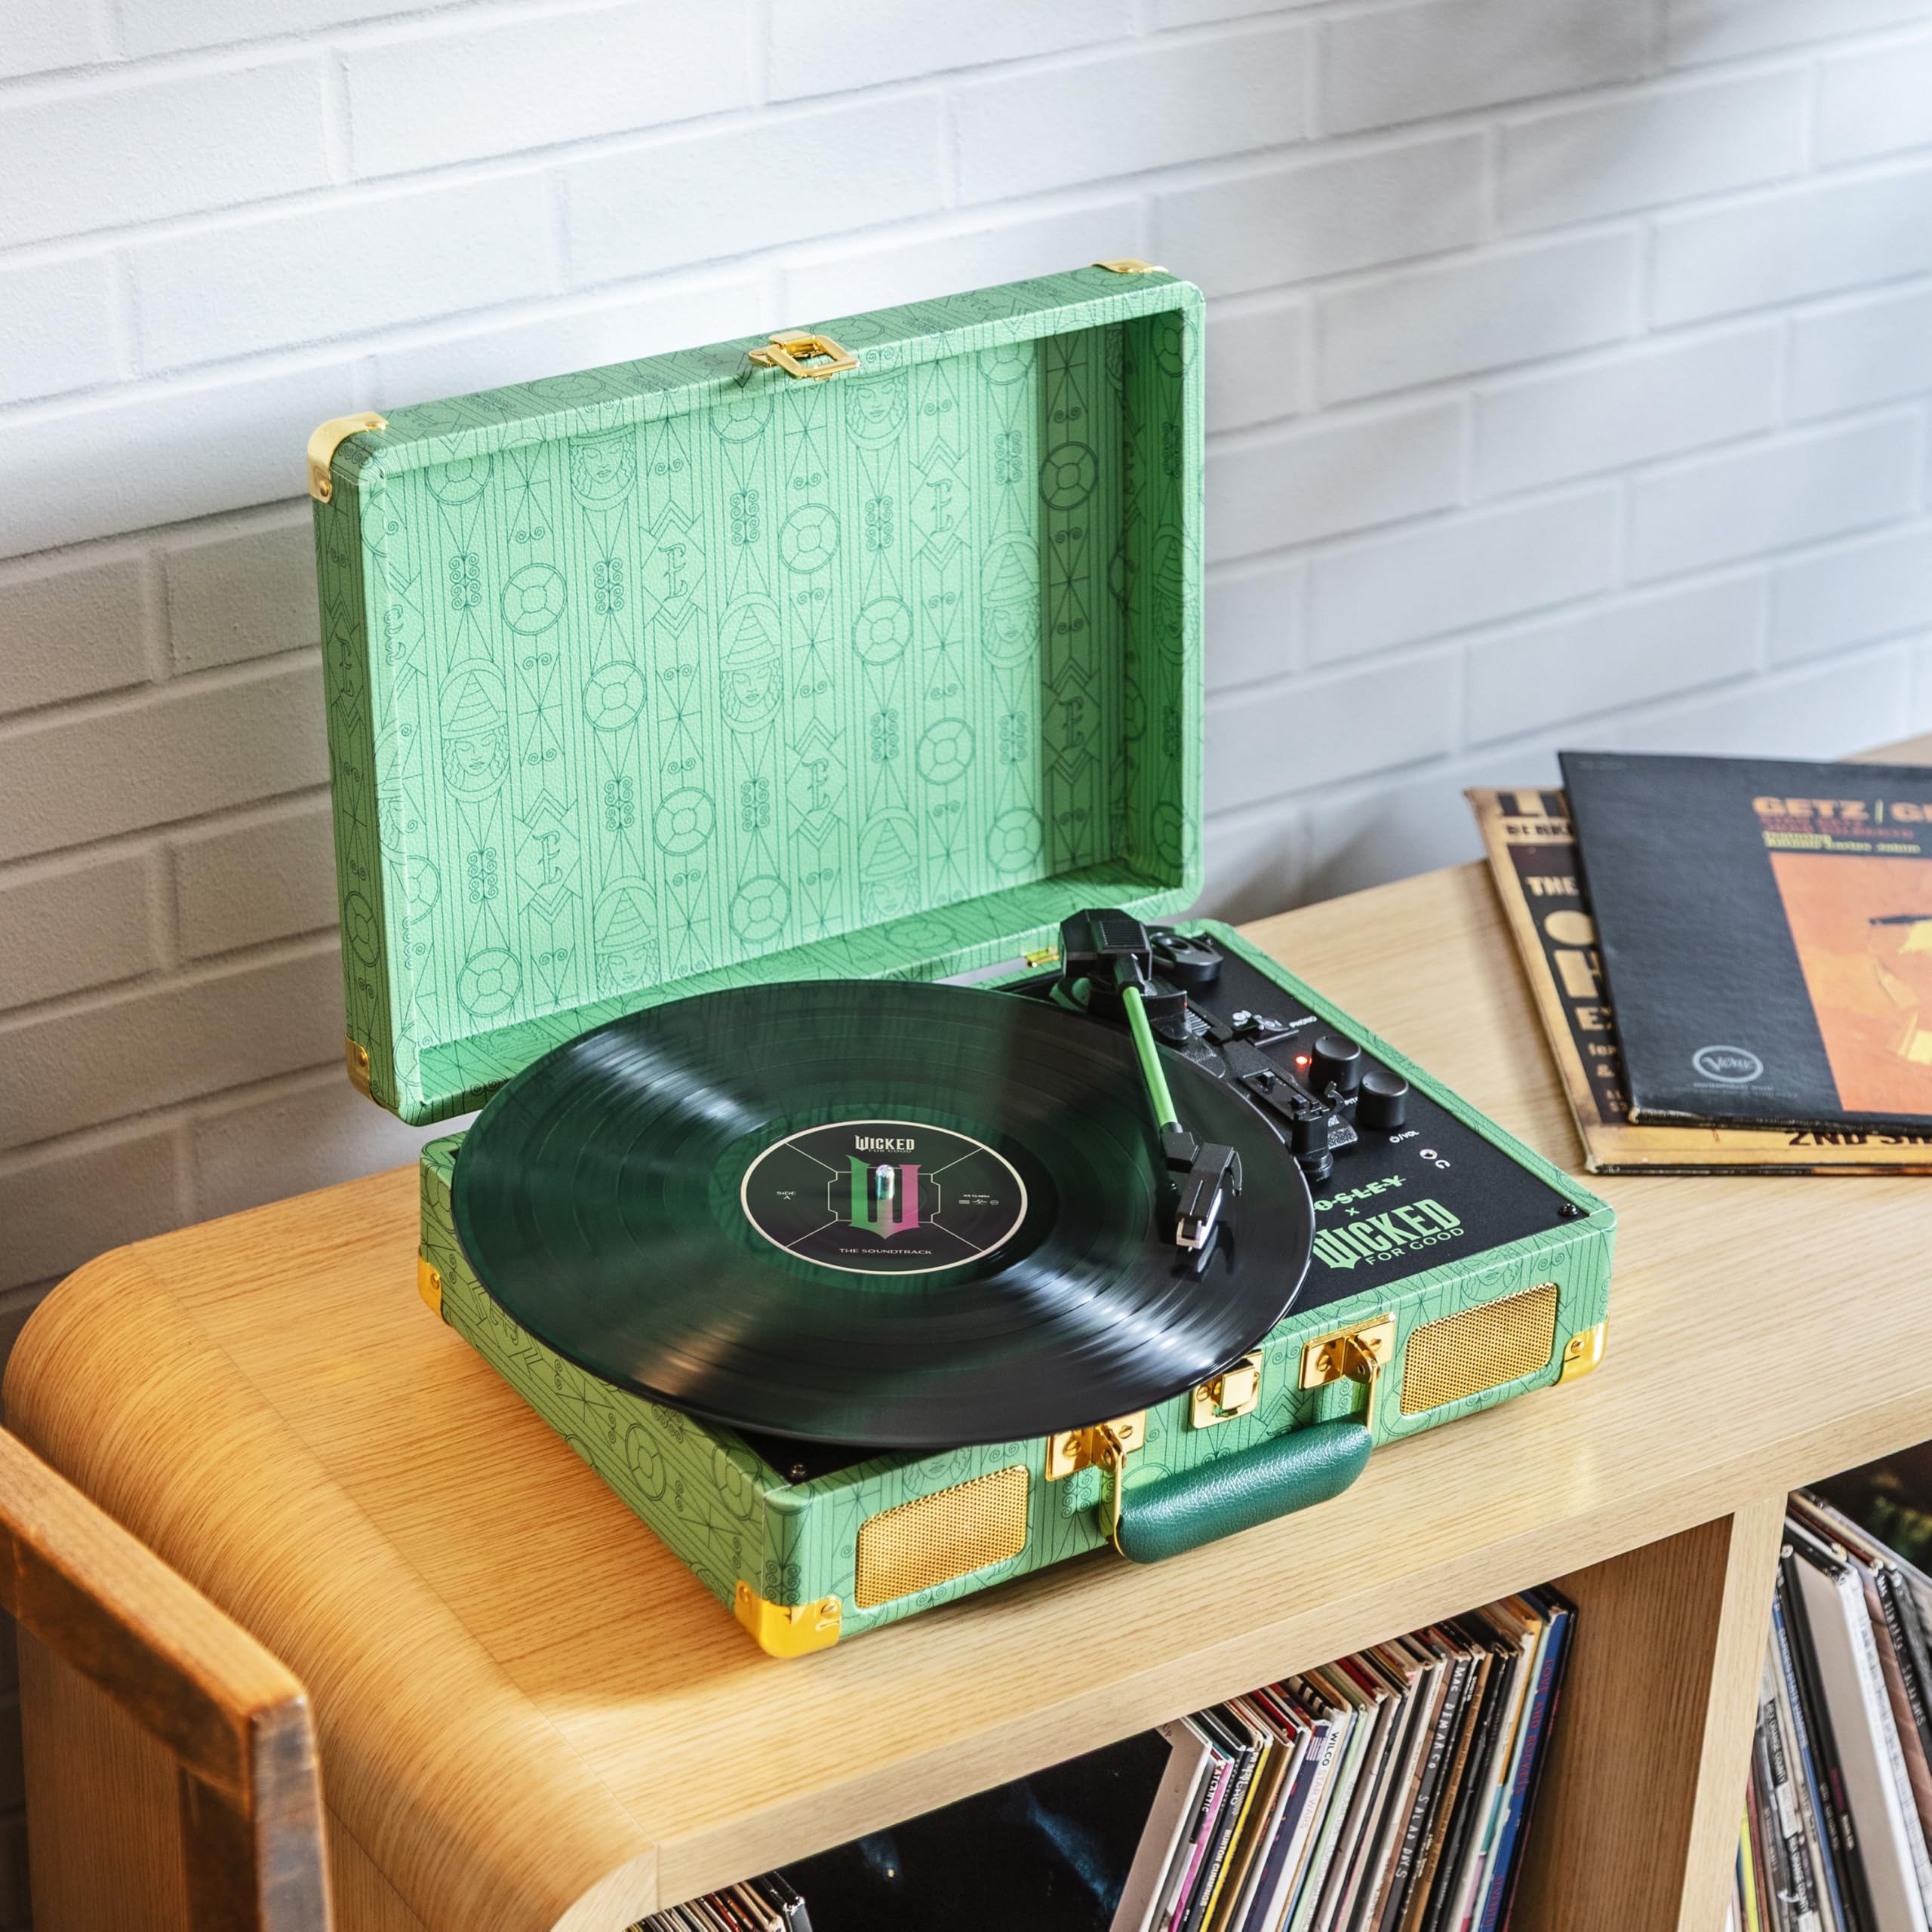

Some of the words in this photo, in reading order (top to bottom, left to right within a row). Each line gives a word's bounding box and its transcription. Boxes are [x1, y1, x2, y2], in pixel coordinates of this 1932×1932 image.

[1525, 876, 1580, 897] THE
[854, 1134, 915, 1152] WICKED
[1314, 1174, 1405, 1211] OSLEY
[1312, 1198, 1462, 1269] WICKED
[1364, 1245, 1408, 1266] FOR
[1410, 1226, 1465, 1251] GOOD
[1450, 1666, 1466, 1693] MAC
[1540, 1658, 1555, 1694] LOVE
[1529, 1702, 1544, 1730] AND
[1321, 1731, 1340, 1767] WILCO
[1427, 1703, 1456, 1770] DEMARCO
[1514, 1735, 1539, 1795] ROCKETS
[1201, 1767, 1222, 1813] ATLANTIC
[1230, 1765, 1248, 1806] TYCHO
[1311, 1768, 1327, 1801] STAR
[1300, 1798, 1318, 1829] WARS
[1406, 1795, 1429, 1841] SALAD
[1217, 1829, 1232, 1863] BURTON
[1395, 1847, 1414, 1879] DAYS
[1200, 1863, 1220, 1906] CUMMINGS
